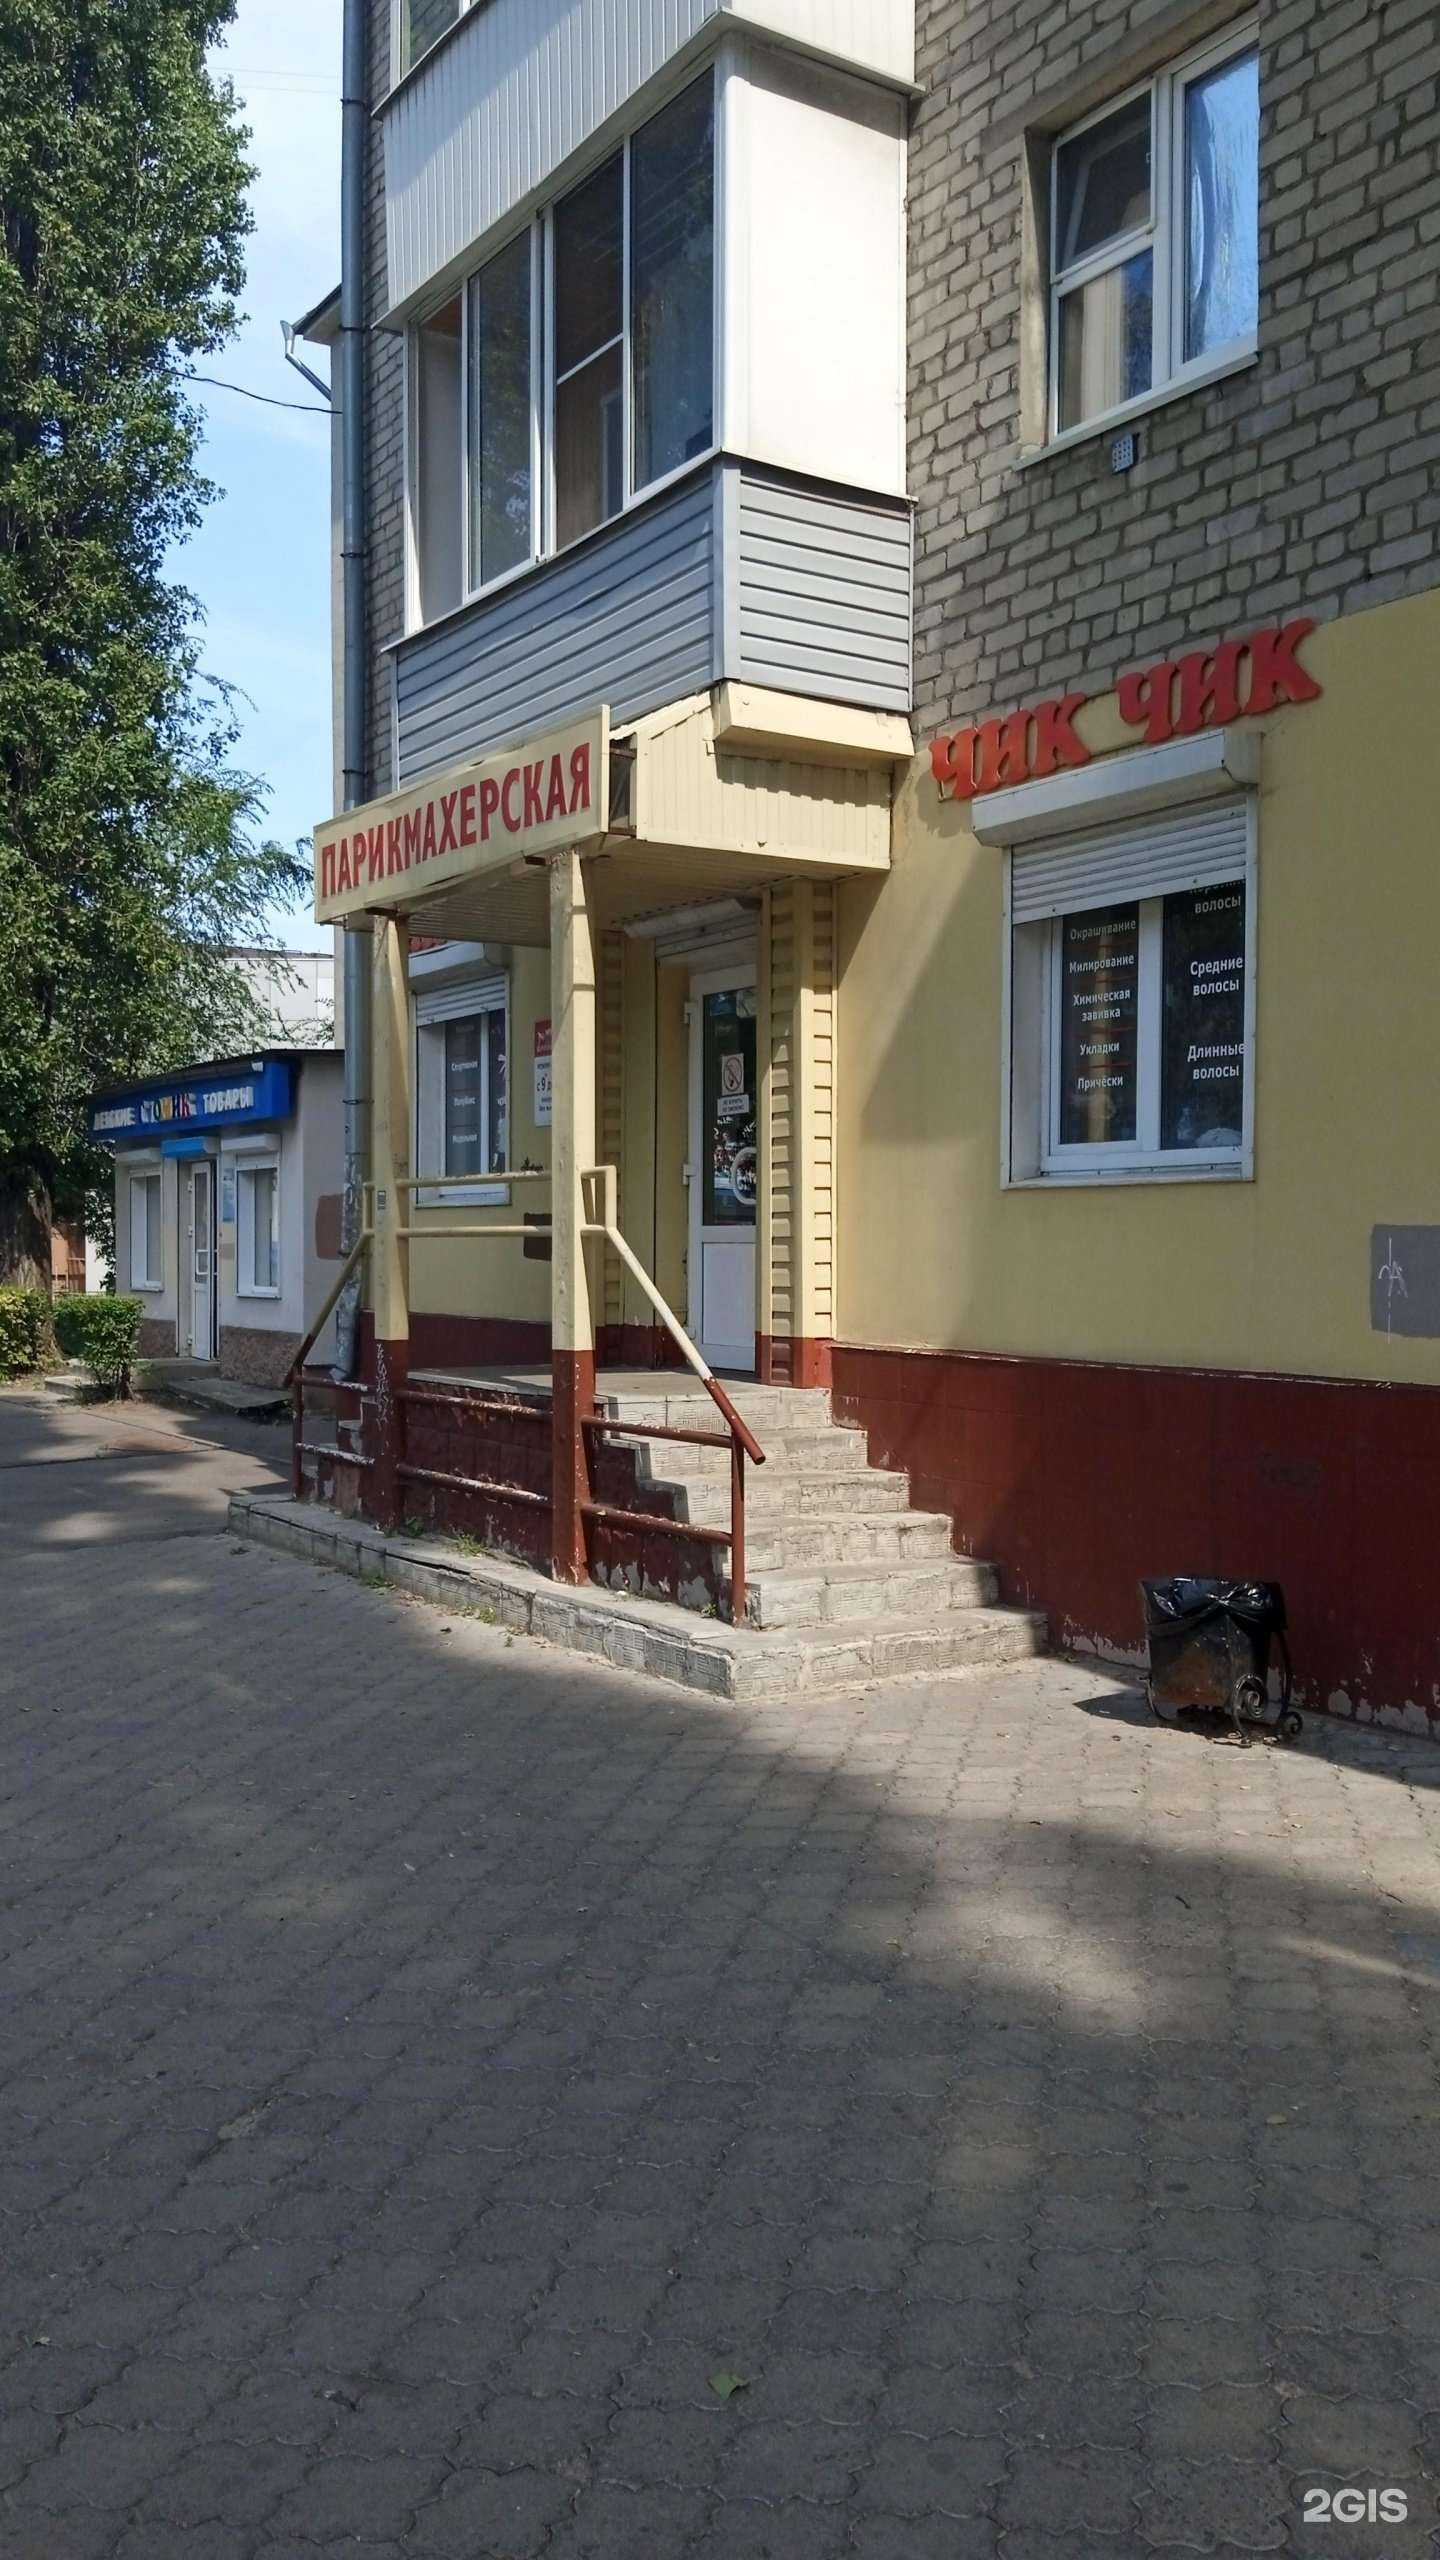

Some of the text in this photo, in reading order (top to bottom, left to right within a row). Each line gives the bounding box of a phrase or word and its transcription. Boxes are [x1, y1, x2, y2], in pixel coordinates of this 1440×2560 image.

[929, 617, 1322, 800] ЧИК ЧИК
[321, 742, 591, 898] ПАРИКМАХЕРСКАЯ
[1194, 895, 1242, 914] волосы
[1069, 919, 1137, 940] Окрашивание
[1190, 956, 1243, 978] Средние
[1192, 979, 1240, 996] волосы
[1072, 989, 1131, 1007] Химическая
[1081, 1008, 1121, 1022] завивка
[1079, 1042, 1120, 1057] Укладки
[1187, 1043, 1246, 1063] Длинные
[1192, 1065, 1240, 1080] волосы
[1077, 1076, 1124, 1091] Прически
[203, 1086, 254, 1114] ТОВАРЫ
